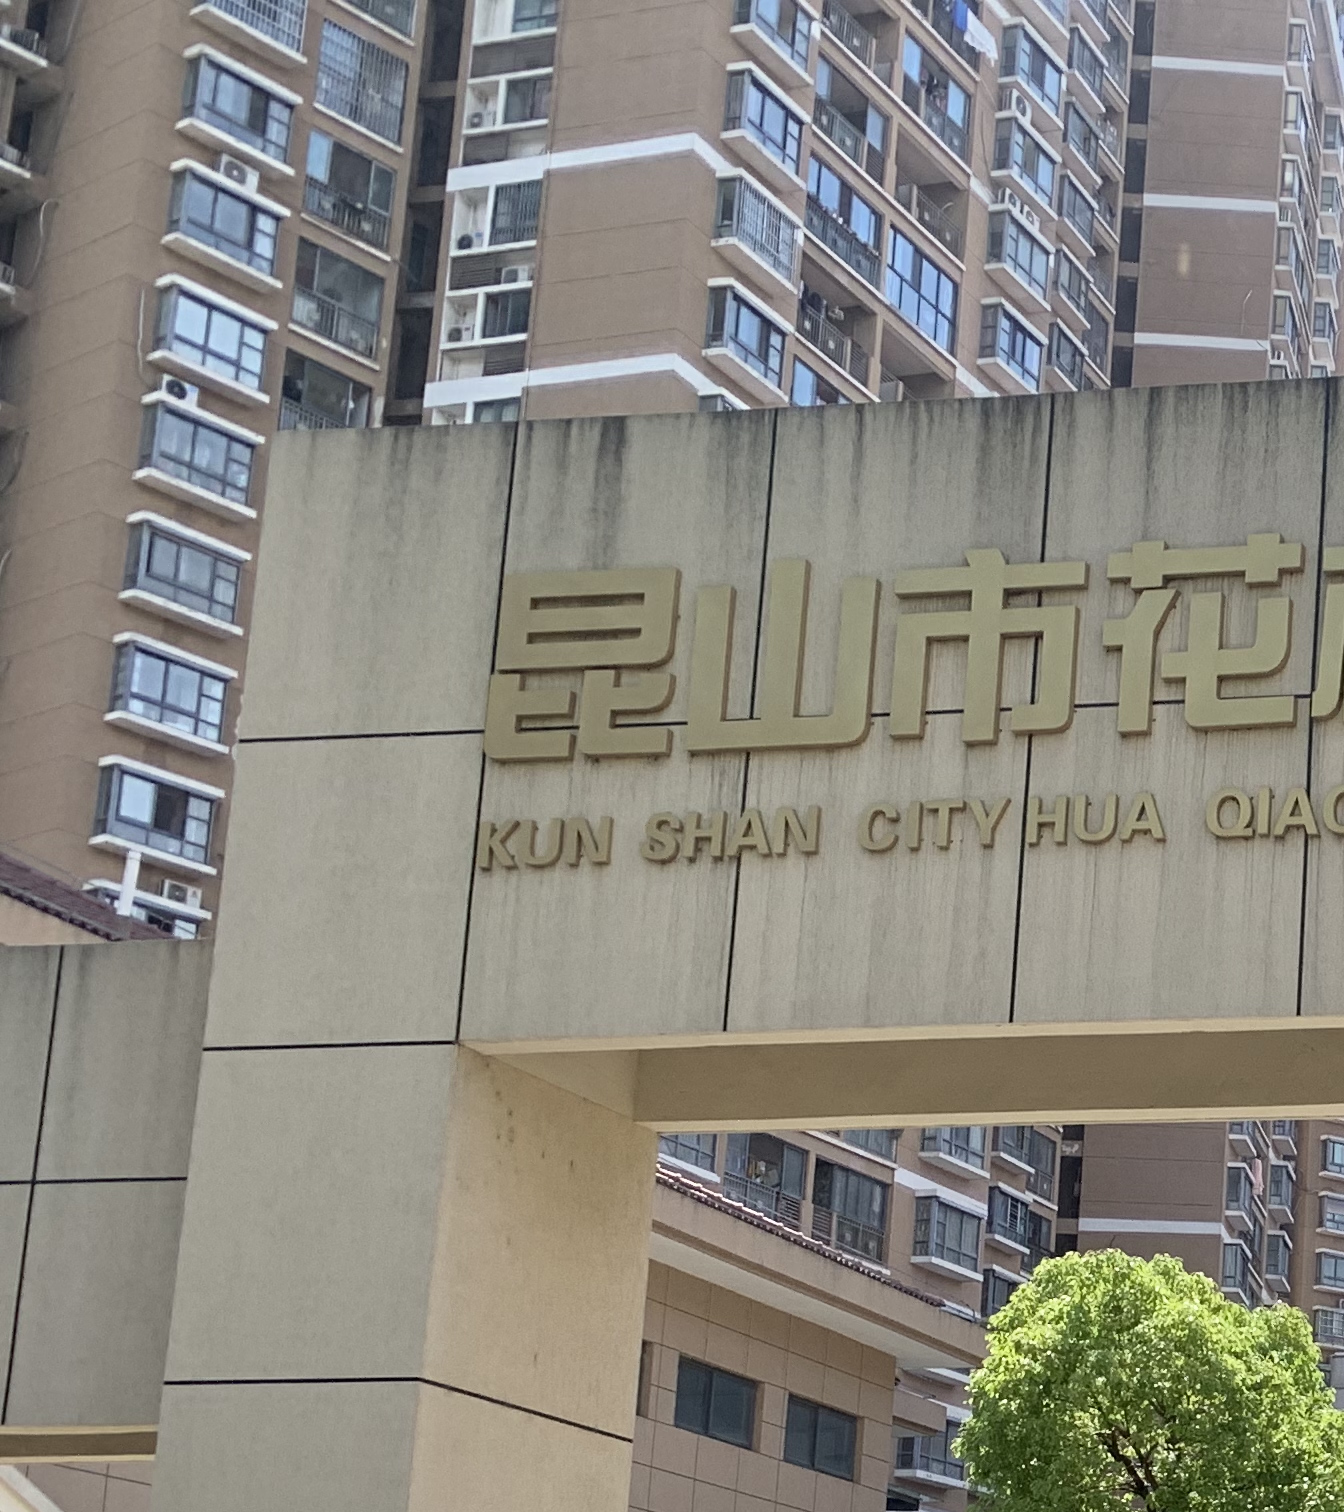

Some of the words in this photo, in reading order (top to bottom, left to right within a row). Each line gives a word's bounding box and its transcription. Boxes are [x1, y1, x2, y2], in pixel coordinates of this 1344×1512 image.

[479, 815, 614, 871] KUN
[639, 804, 822, 864] SHAN
[857, 796, 1012, 853] CITY
[1026, 791, 1166, 847] HUA
